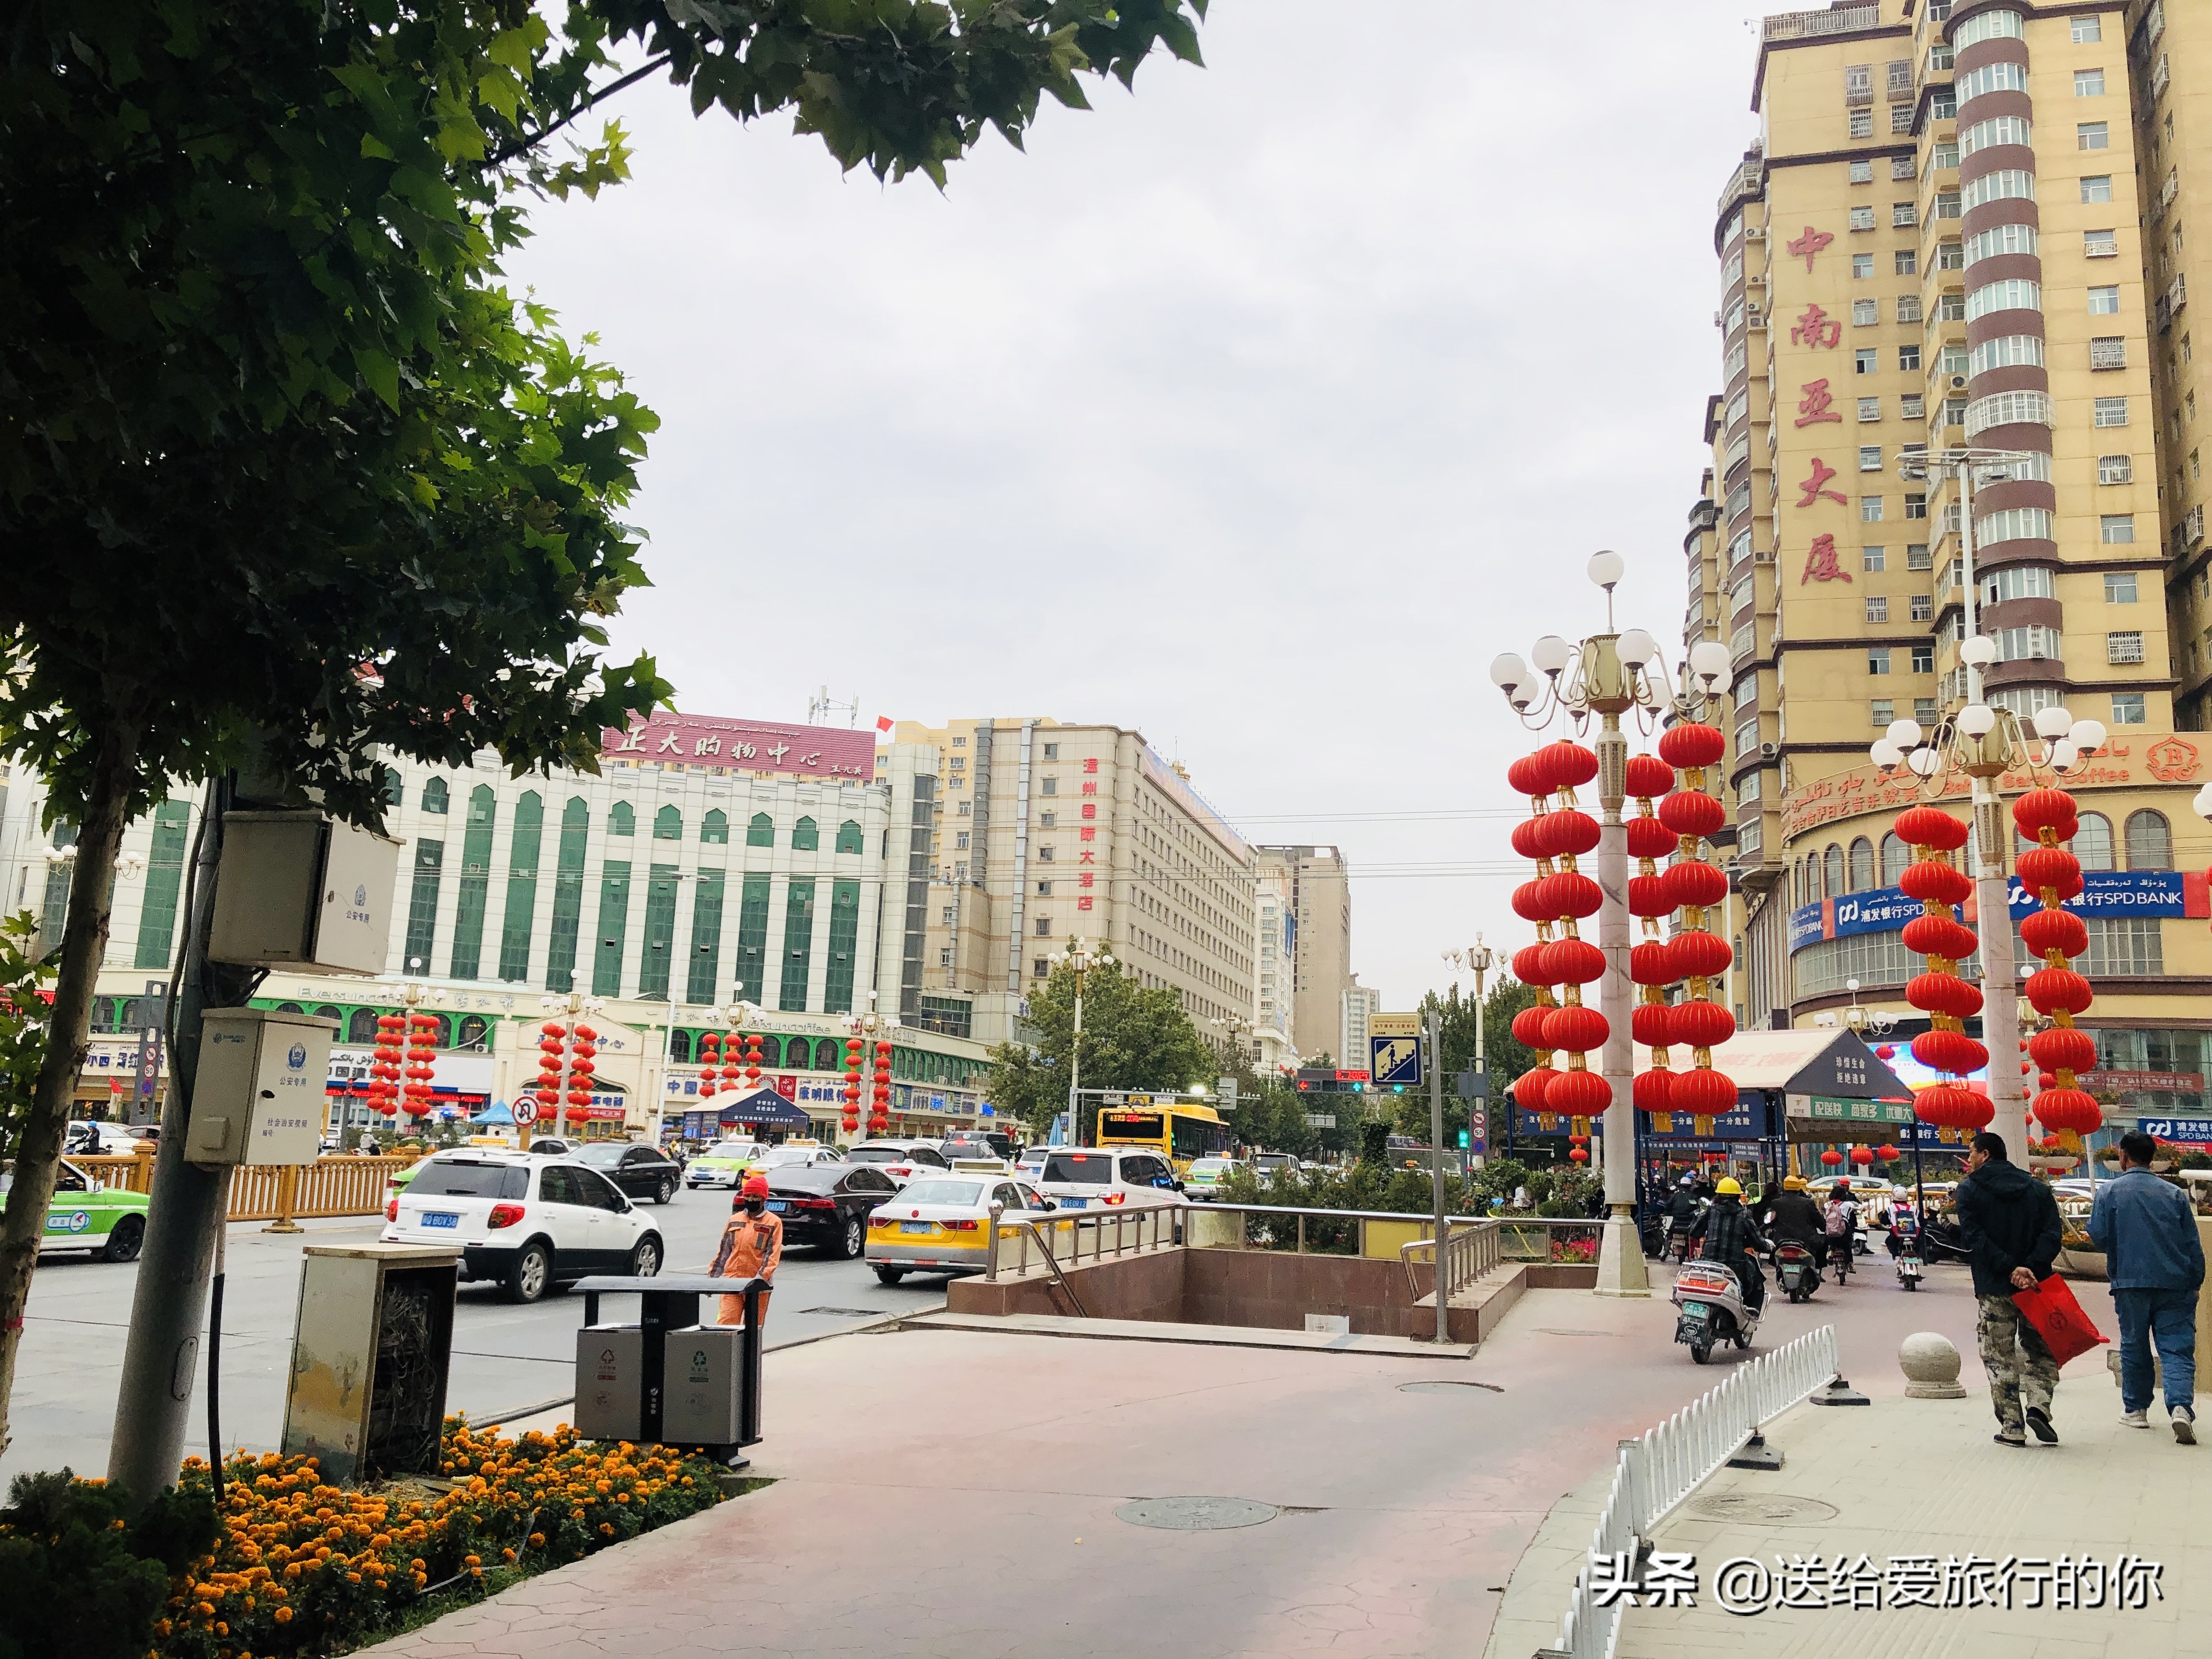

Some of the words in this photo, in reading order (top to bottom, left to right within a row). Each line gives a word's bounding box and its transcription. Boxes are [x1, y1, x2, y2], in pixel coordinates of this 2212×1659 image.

[1787, 226, 1853, 585] 中南亚大厦
[2063, 767, 2130, 784] Coffee
[2137, 893, 2183, 905] BANK
[346, 910, 370, 923] 公安专用
[1836, 1057, 1865, 1070] 珍惜生命
[144, 1067, 155, 1075] 50
[280, 1076, 307, 1087] 公安专用
[1851, 1103, 1878, 1118] 商家多
[268, 1118, 307, 1128] 社会治安视频
